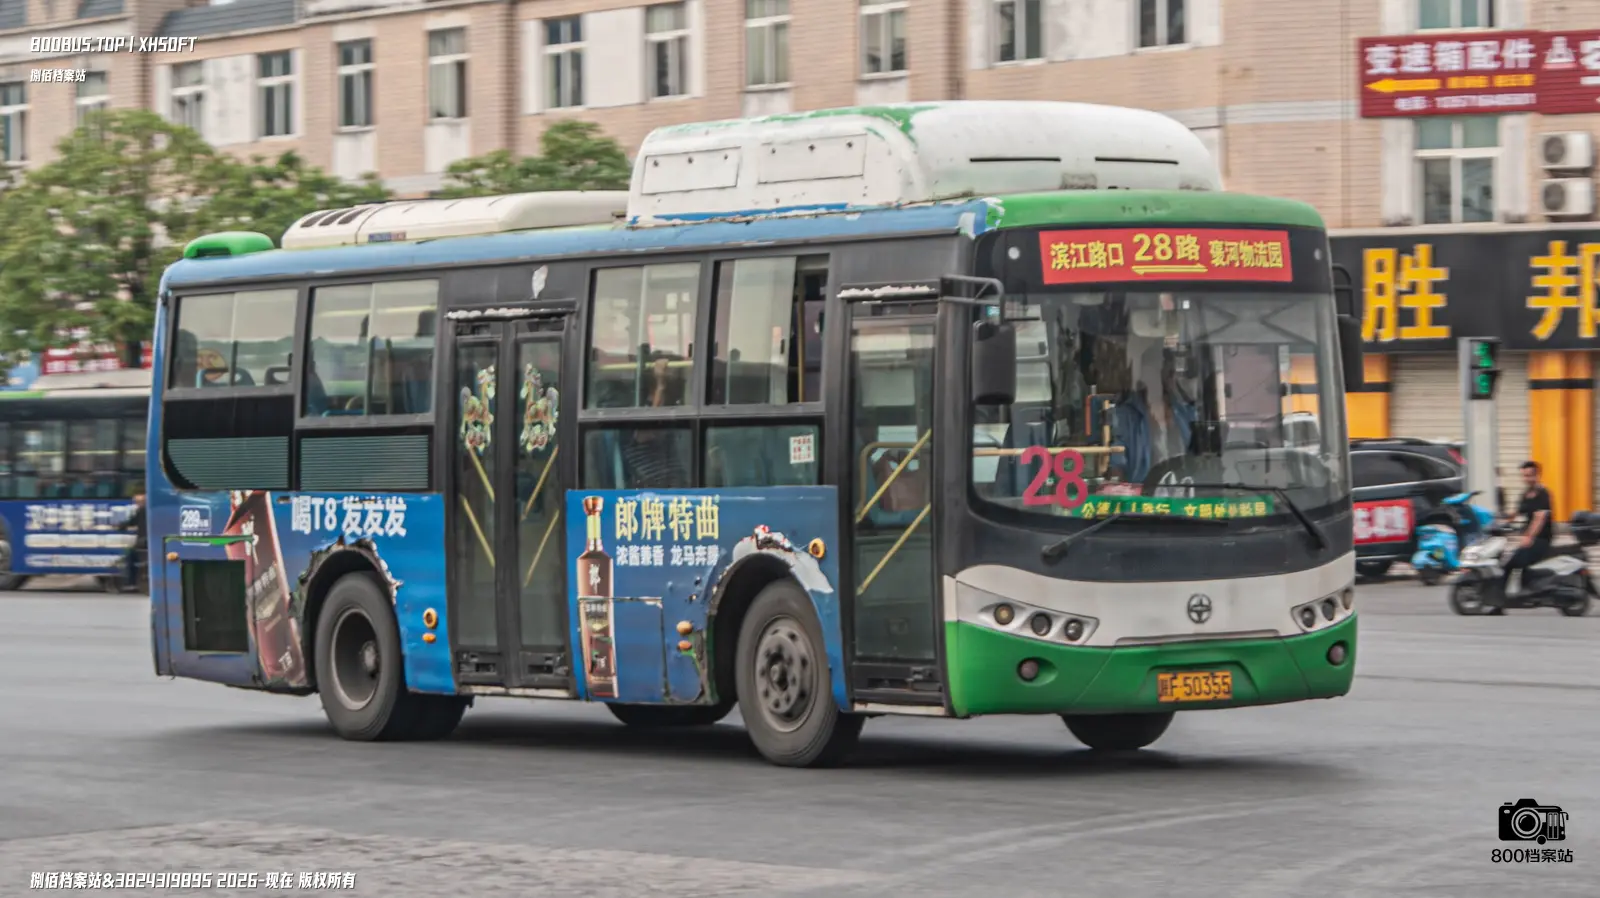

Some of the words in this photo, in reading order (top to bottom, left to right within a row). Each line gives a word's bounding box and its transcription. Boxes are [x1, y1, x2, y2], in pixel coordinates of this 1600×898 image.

[1364, 38, 1536, 75] 变速箱配件
[1050, 241, 1125, 271] 滨江路口
[1132, 233, 1200, 263] 28路
[1020, 445, 1089, 509] 28
[291, 495, 337, 535] 喝T8
[342, 496, 407, 537] 发发发
[615, 496, 719, 541] 郎牌特曲
[616, 545, 664, 566] 浓酱兼香
[670, 544, 719, 566] 龙马奔腾
